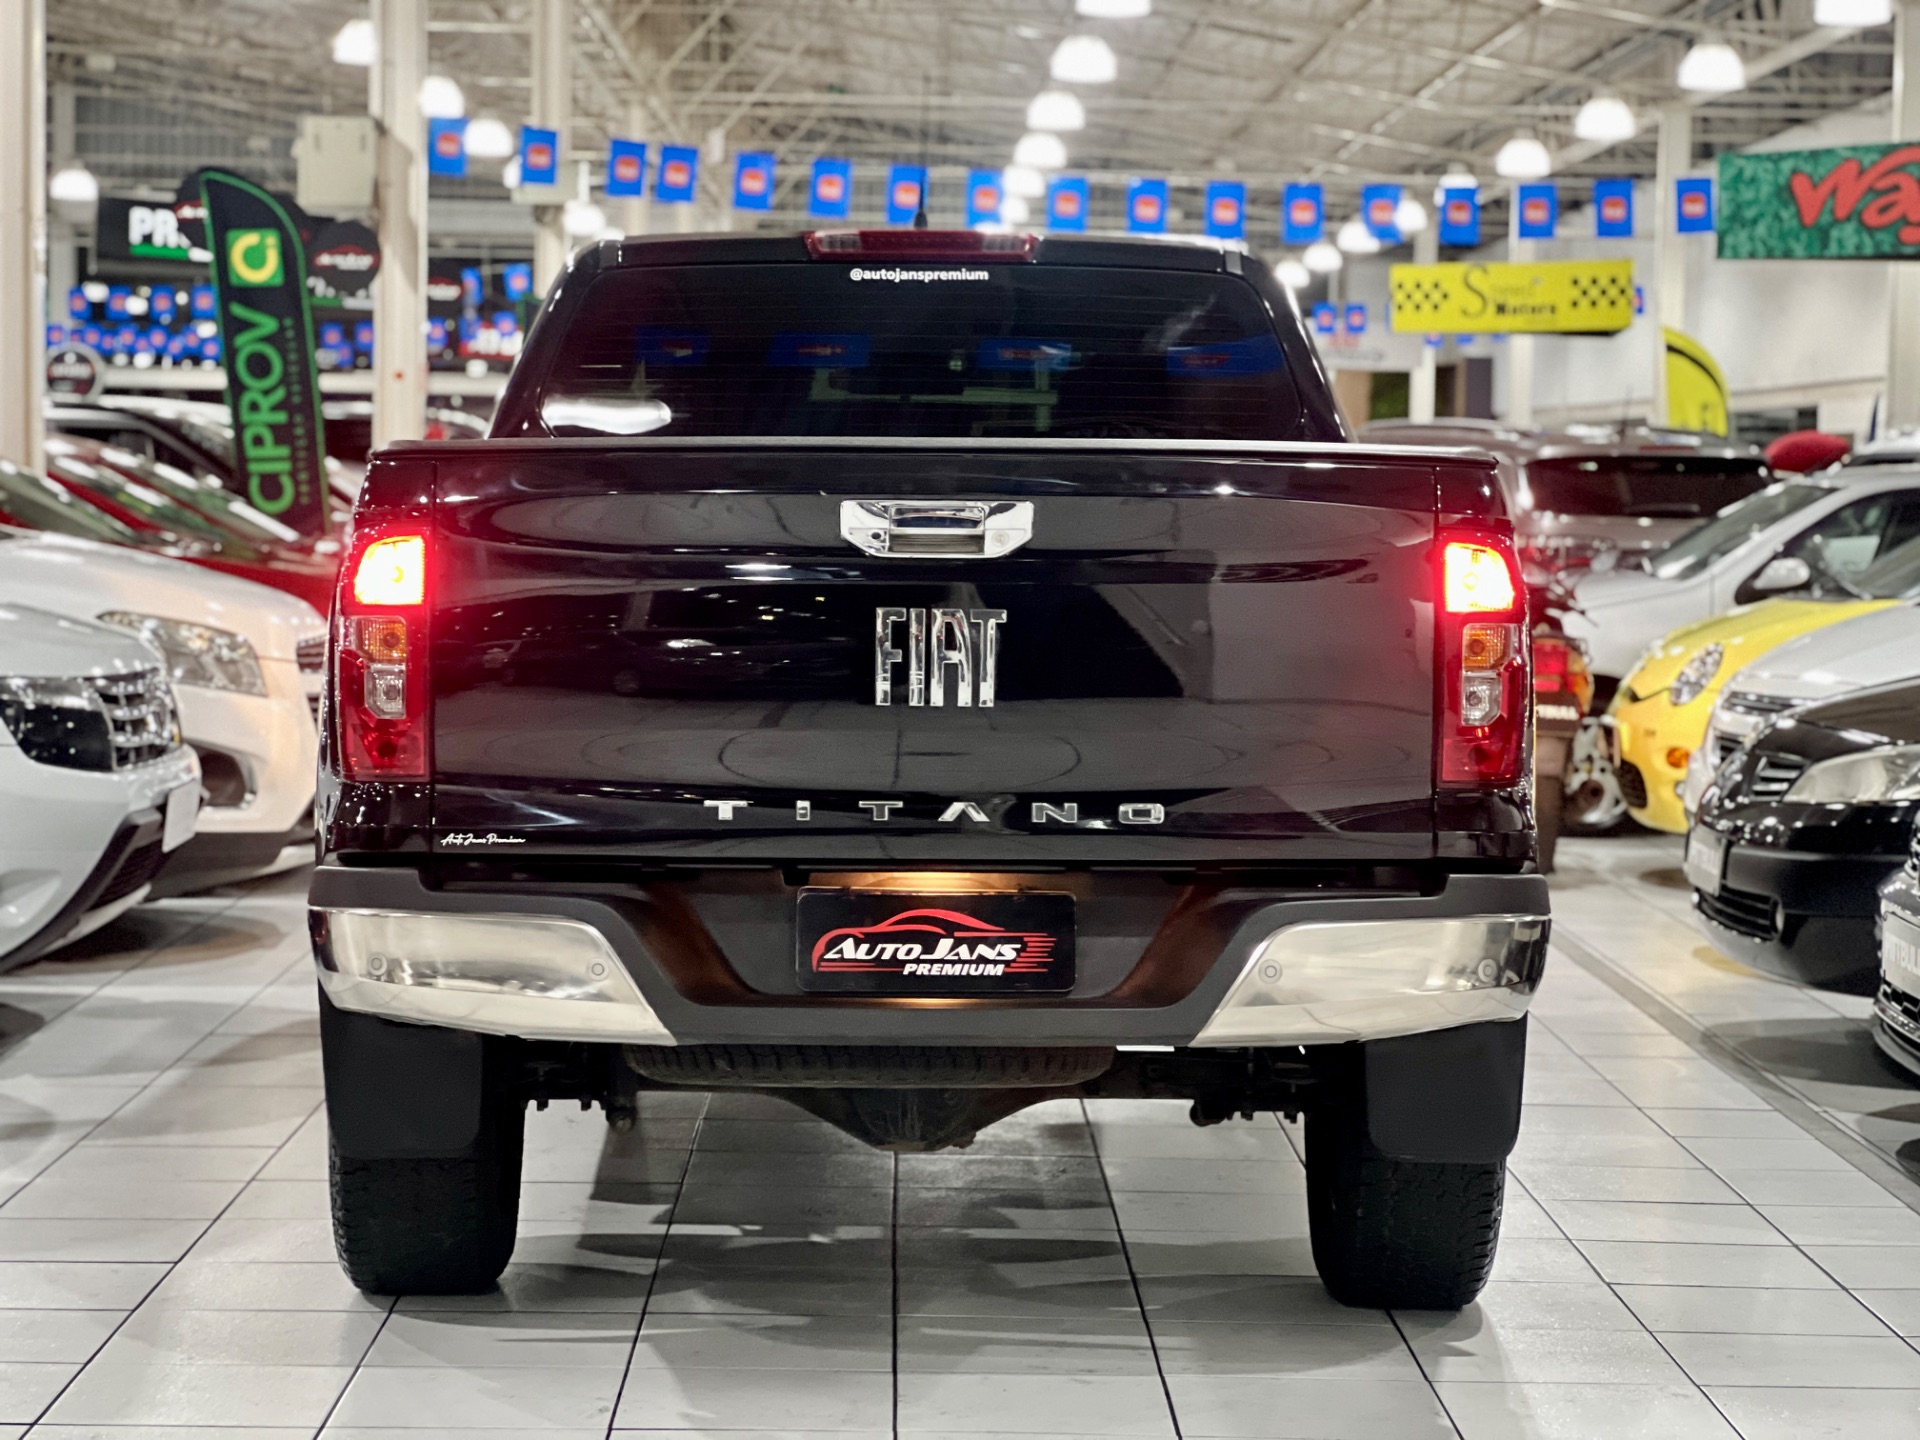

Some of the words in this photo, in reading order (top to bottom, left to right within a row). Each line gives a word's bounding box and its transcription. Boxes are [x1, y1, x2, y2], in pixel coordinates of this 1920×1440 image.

[850, 267, 989, 283] @autojanspremium
[228, 302, 295, 514] CIPROV
[875, 607, 1007, 707] FIAT
[703, 800, 1165, 824] TITANO
[902, 963, 1006, 976] PREMIUM
